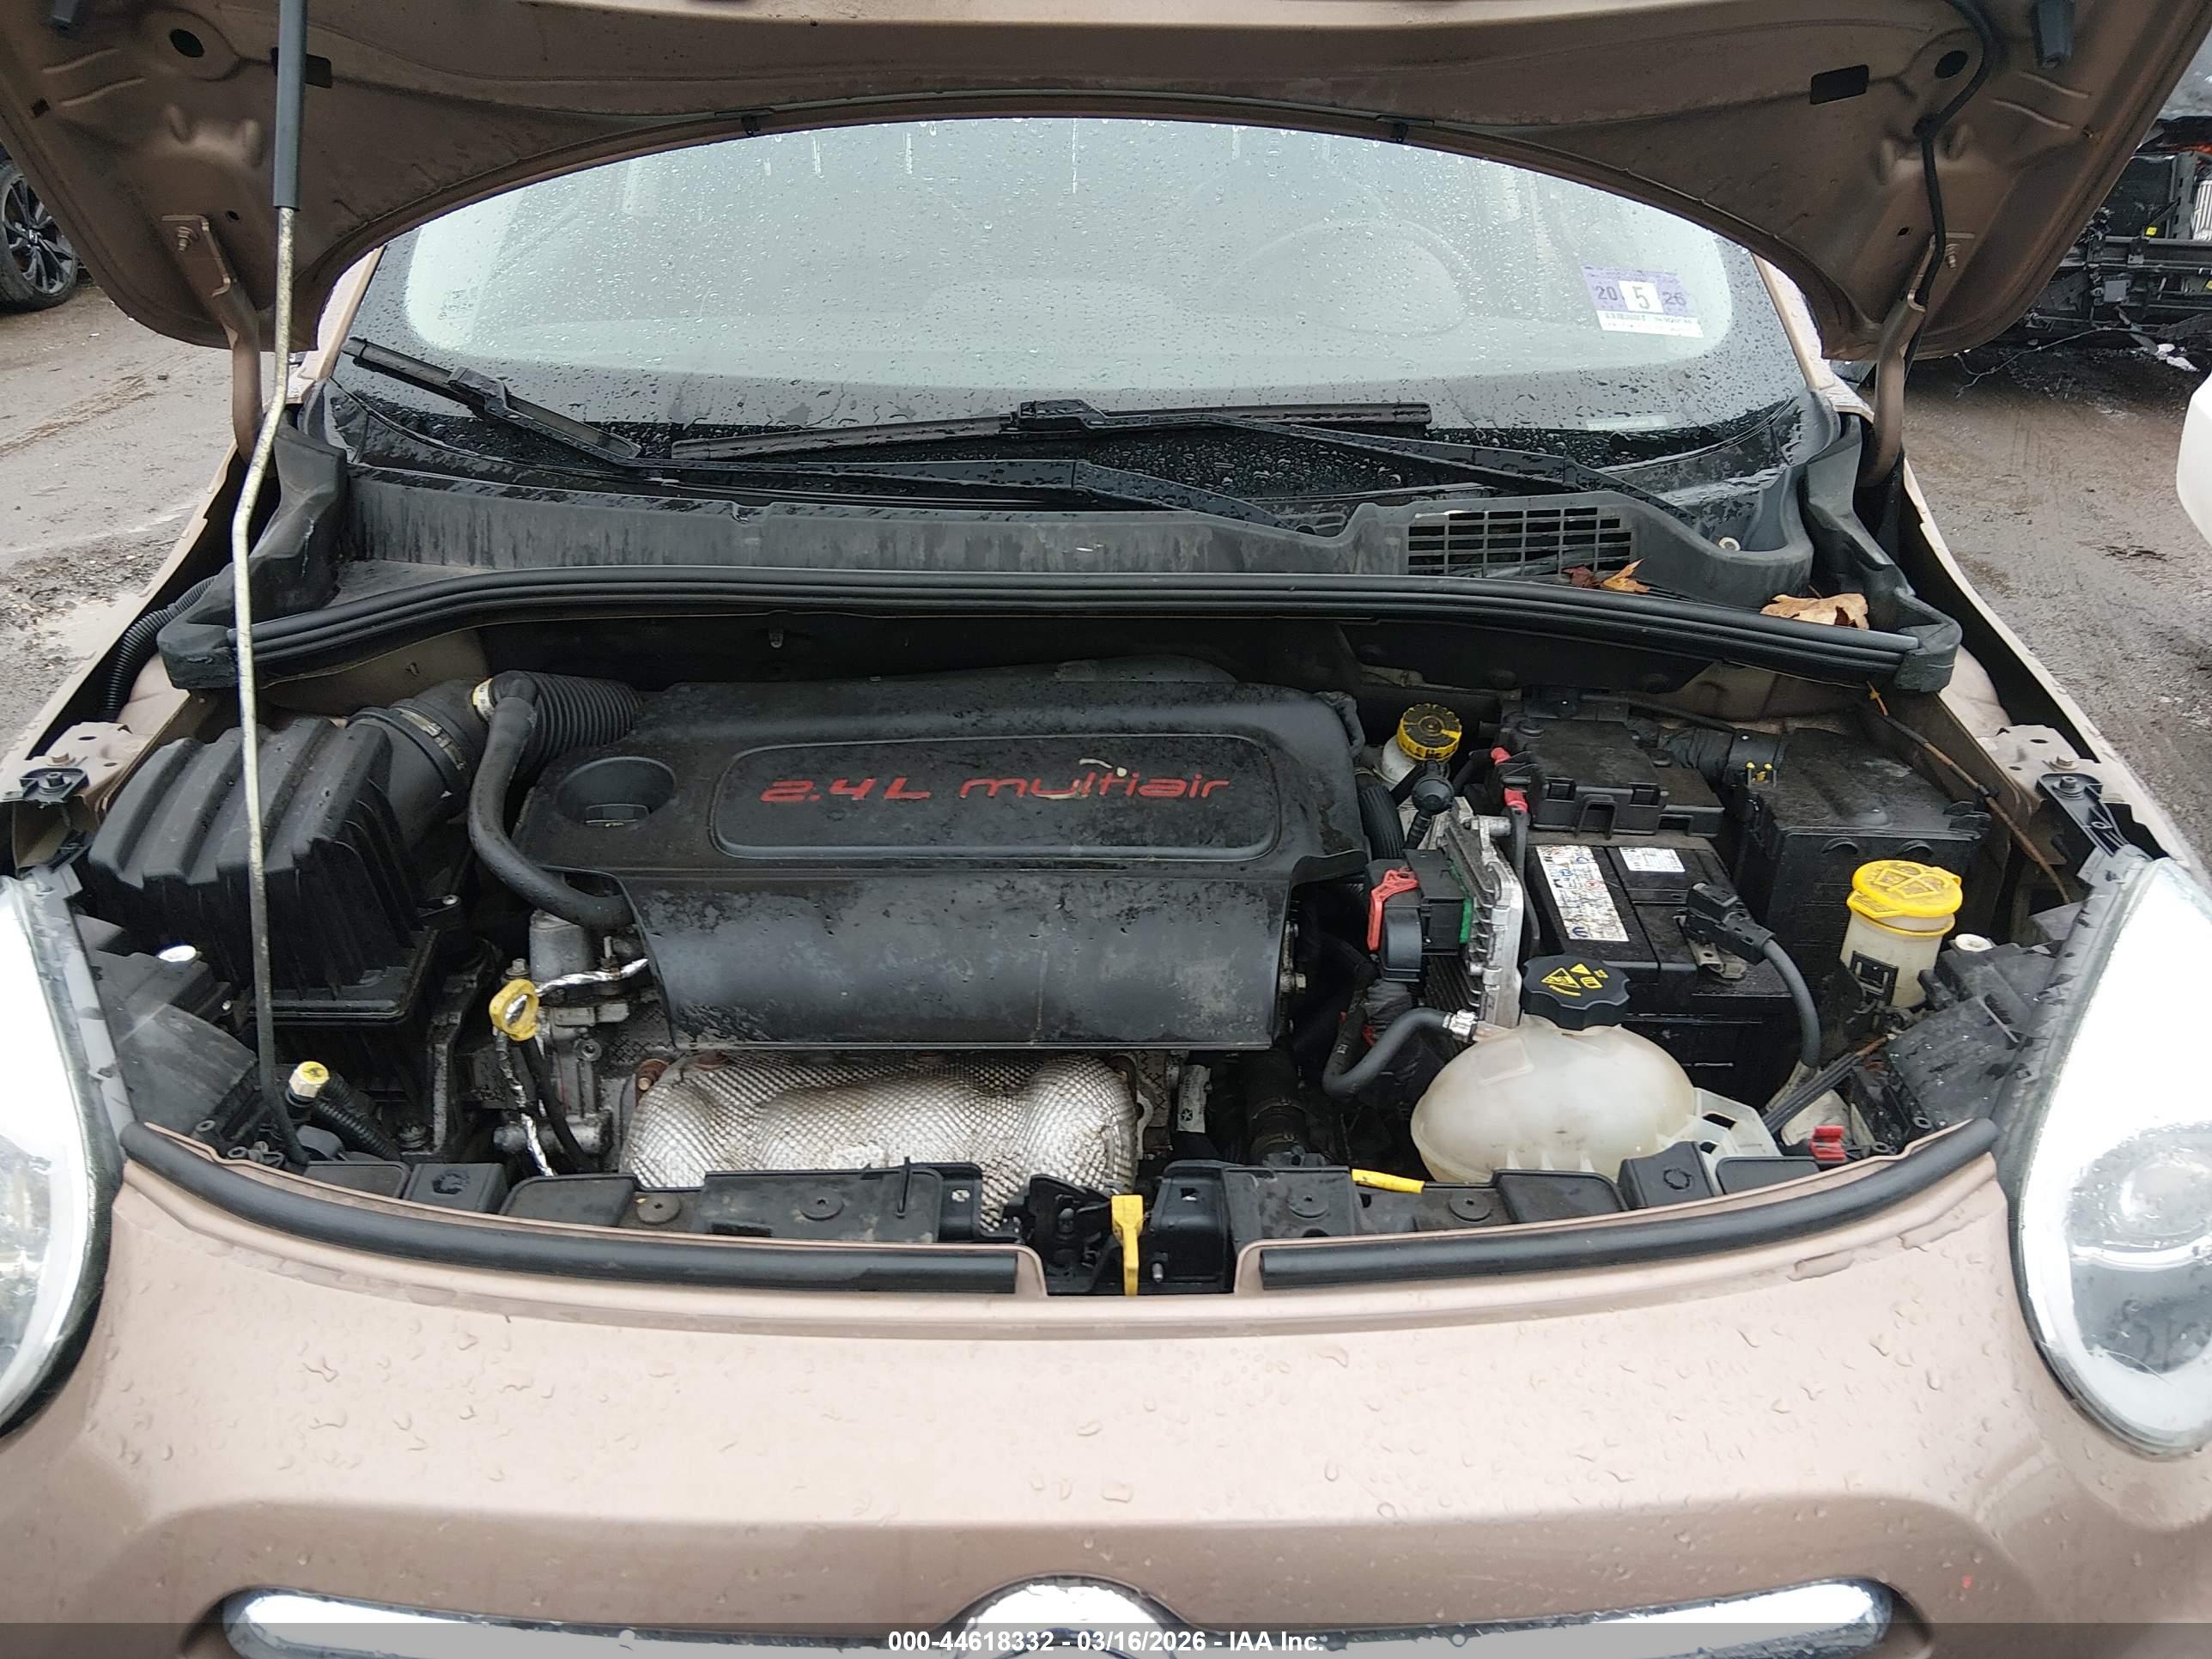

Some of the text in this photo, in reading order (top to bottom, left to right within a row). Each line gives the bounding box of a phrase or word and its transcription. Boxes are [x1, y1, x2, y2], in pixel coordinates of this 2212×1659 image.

[1594, 285, 1619, 301] 20
[1632, 286, 1650, 310] 5
[959, 771, 1229, 800] multiair
